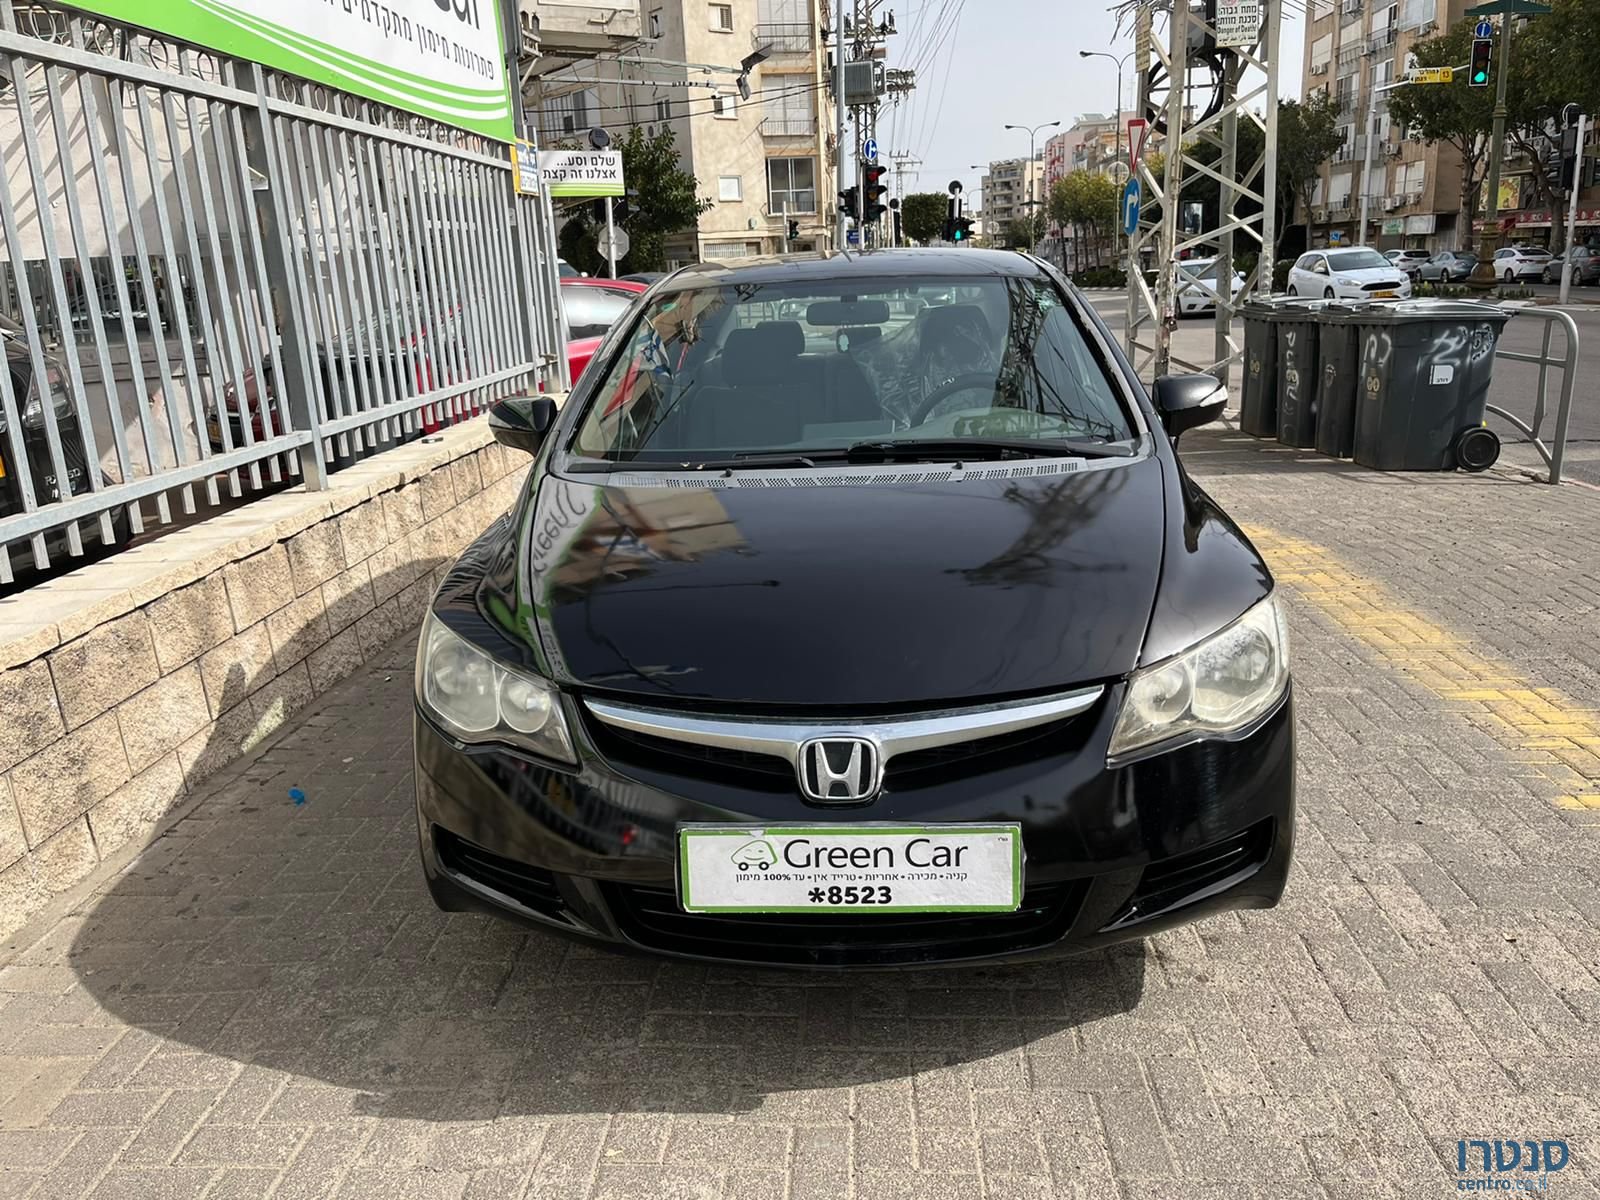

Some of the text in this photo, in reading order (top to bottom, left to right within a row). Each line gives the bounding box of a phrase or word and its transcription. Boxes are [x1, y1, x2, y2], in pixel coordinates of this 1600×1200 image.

[1241, 5, 1256, 13] מתח
[1239, 15, 1256, 24] סכנת
[416, 23, 450, 59] מימון
[453, 42, 494, 80] פתרונות
[1442, 70, 1450, 79] 13
[556, 155, 615, 167] שלם וסע...
[542, 168, 617, 182] אצלנו זה קצת
[783, 838, 969, 869] Green Car
[735, 872, 968, 883] קניה מכירה אחריות טרייד אין עד 100% מימון
